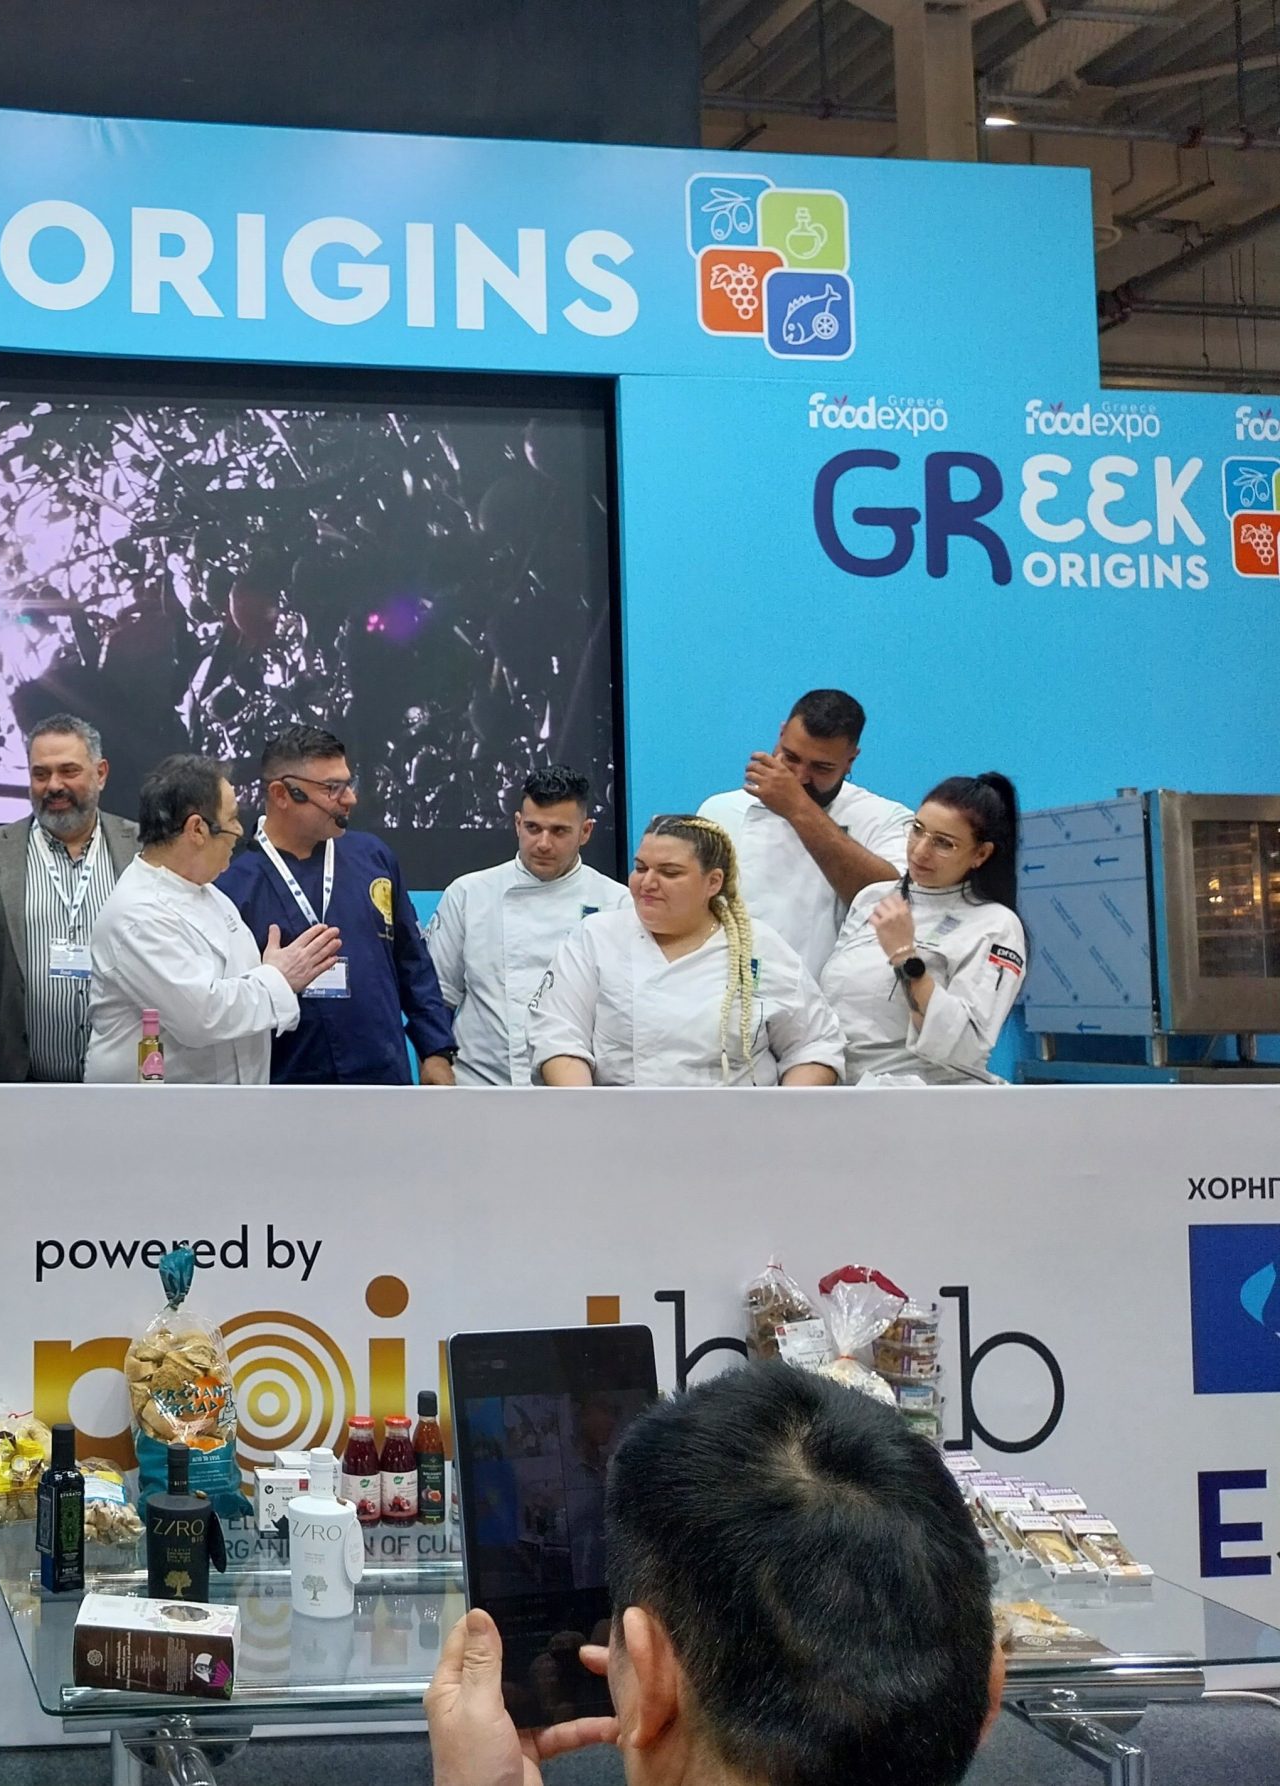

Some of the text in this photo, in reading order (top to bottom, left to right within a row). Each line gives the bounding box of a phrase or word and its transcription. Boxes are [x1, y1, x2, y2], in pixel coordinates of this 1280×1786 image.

[0, 197, 640, 338] ORIGINS
[808, 392, 948, 437] foodexpo
[888, 394, 944, 407] Greece
[1025, 399, 1160, 443] foodexpo
[812, 448, 1206, 586] GREEK
[1022, 551, 1210, 591] ORIGINS
[266, 1223, 322, 1281] by
[381, 1535, 411, 1555] OF
